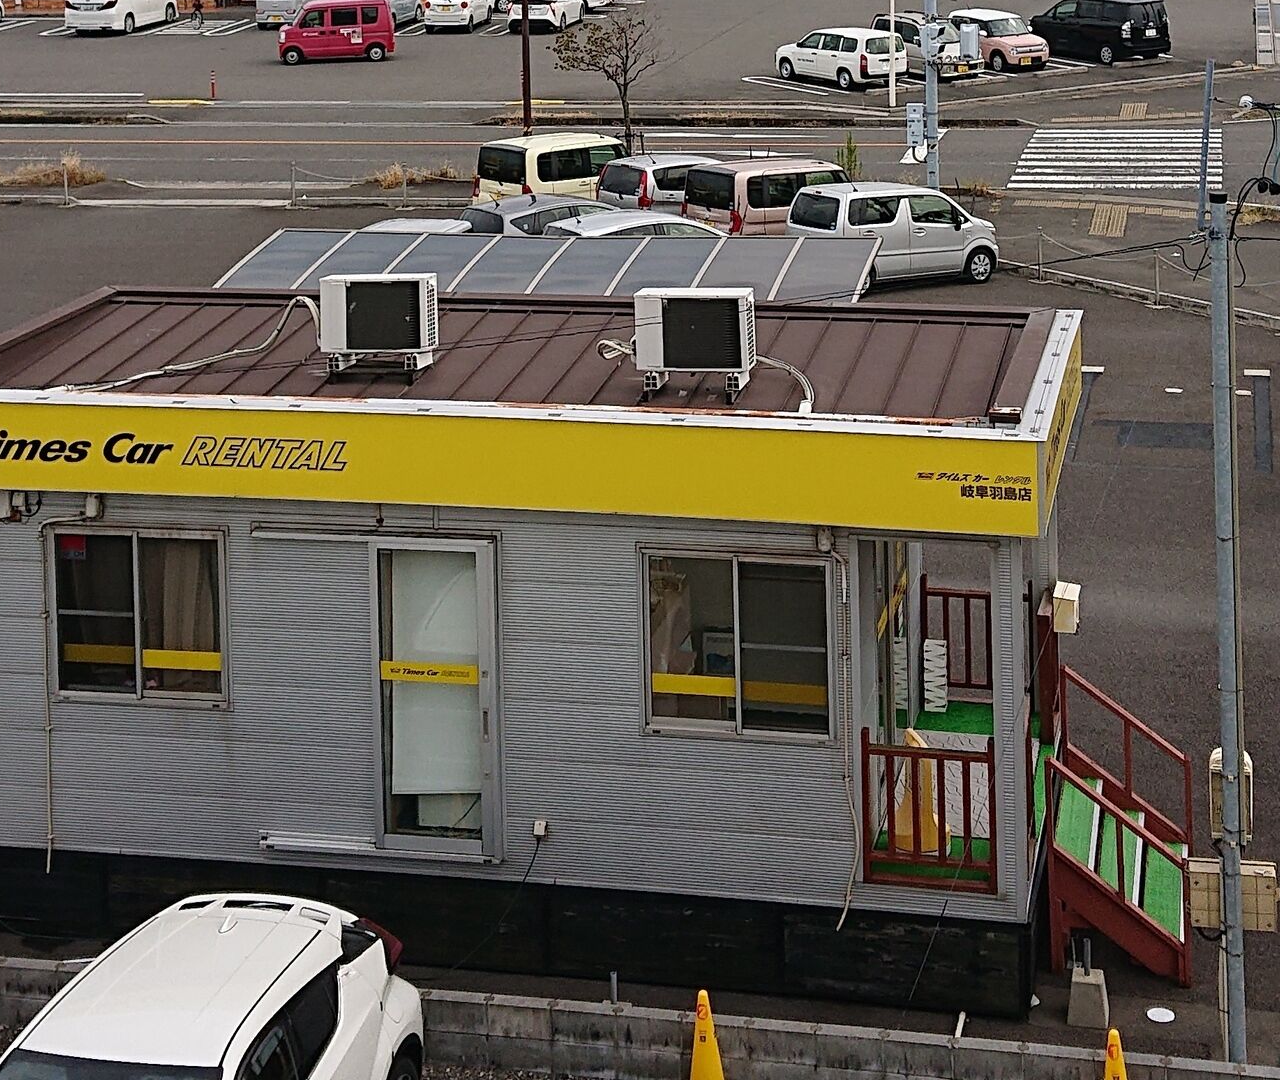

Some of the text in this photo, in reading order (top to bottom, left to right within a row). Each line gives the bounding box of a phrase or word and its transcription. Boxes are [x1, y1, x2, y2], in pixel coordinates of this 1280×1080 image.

[102, 432, 175, 465] Car
[181, 435, 348, 472] RENTAL
[935, 472, 972, 482] タイムズ
[972, 473, 990, 483] カー
[960, 484, 1032, 502] 岐阜羽島店
[402, 667, 425, 676] Times
